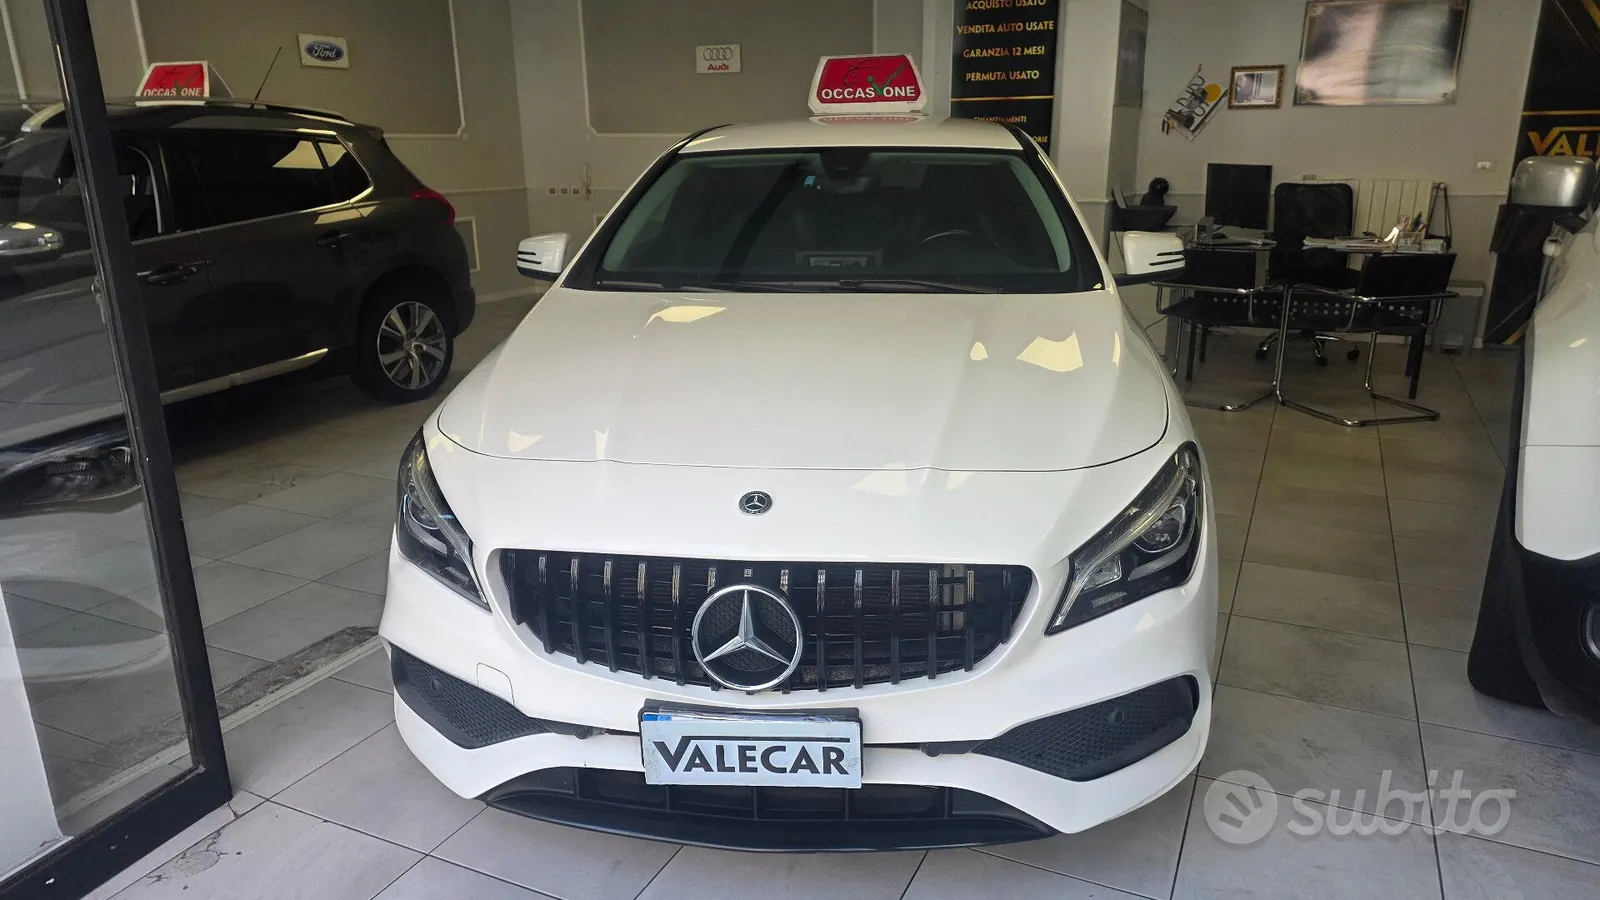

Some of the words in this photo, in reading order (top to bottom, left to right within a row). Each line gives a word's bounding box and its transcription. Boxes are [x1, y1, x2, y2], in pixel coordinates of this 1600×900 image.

[966, 0, 1013, 10] ACQUISTO
[957, 24, 995, 34] VENDITA
[997, 22, 1024, 32] AUTO
[1025, 20, 1055, 31] USATE
[312, 43, 338, 58] Ford
[963, 47, 1010, 58] GARANZIA
[1012, 46, 1022, 56] 12
[1023, 45, 1045, 56] MESI
[707, 63, 730, 71] Audi
[965, 72, 1007, 81] PERMUTA
[1009, 70, 1040, 80] USATO
[652, 735, 851, 775] VALECAR
